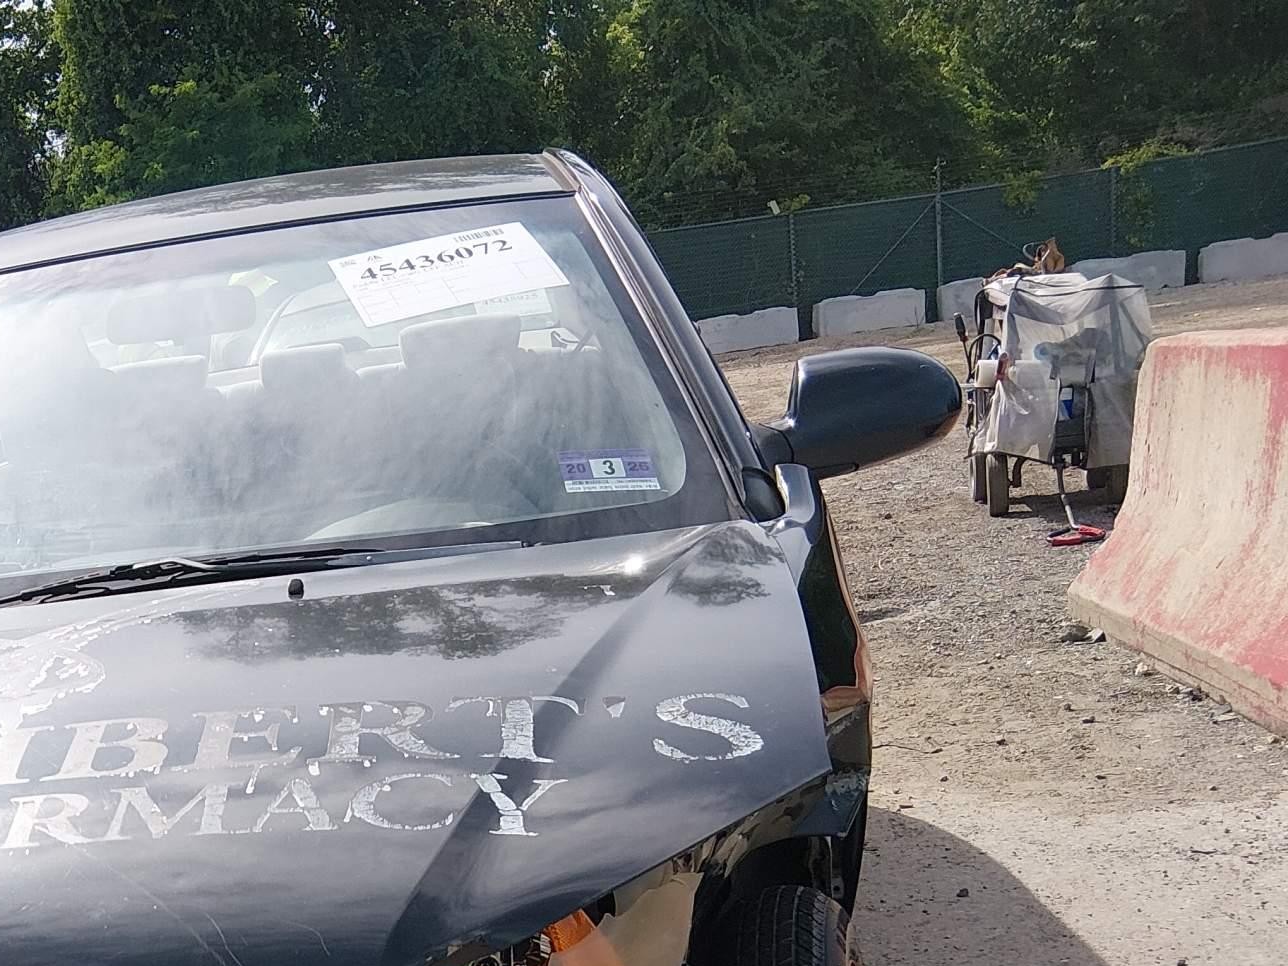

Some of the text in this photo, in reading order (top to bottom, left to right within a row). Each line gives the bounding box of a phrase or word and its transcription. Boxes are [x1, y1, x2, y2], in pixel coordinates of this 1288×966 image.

[361, 239, 512, 281] 45436072
[566, 463, 586, 474] 20
[602, 459, 616, 475] 3
